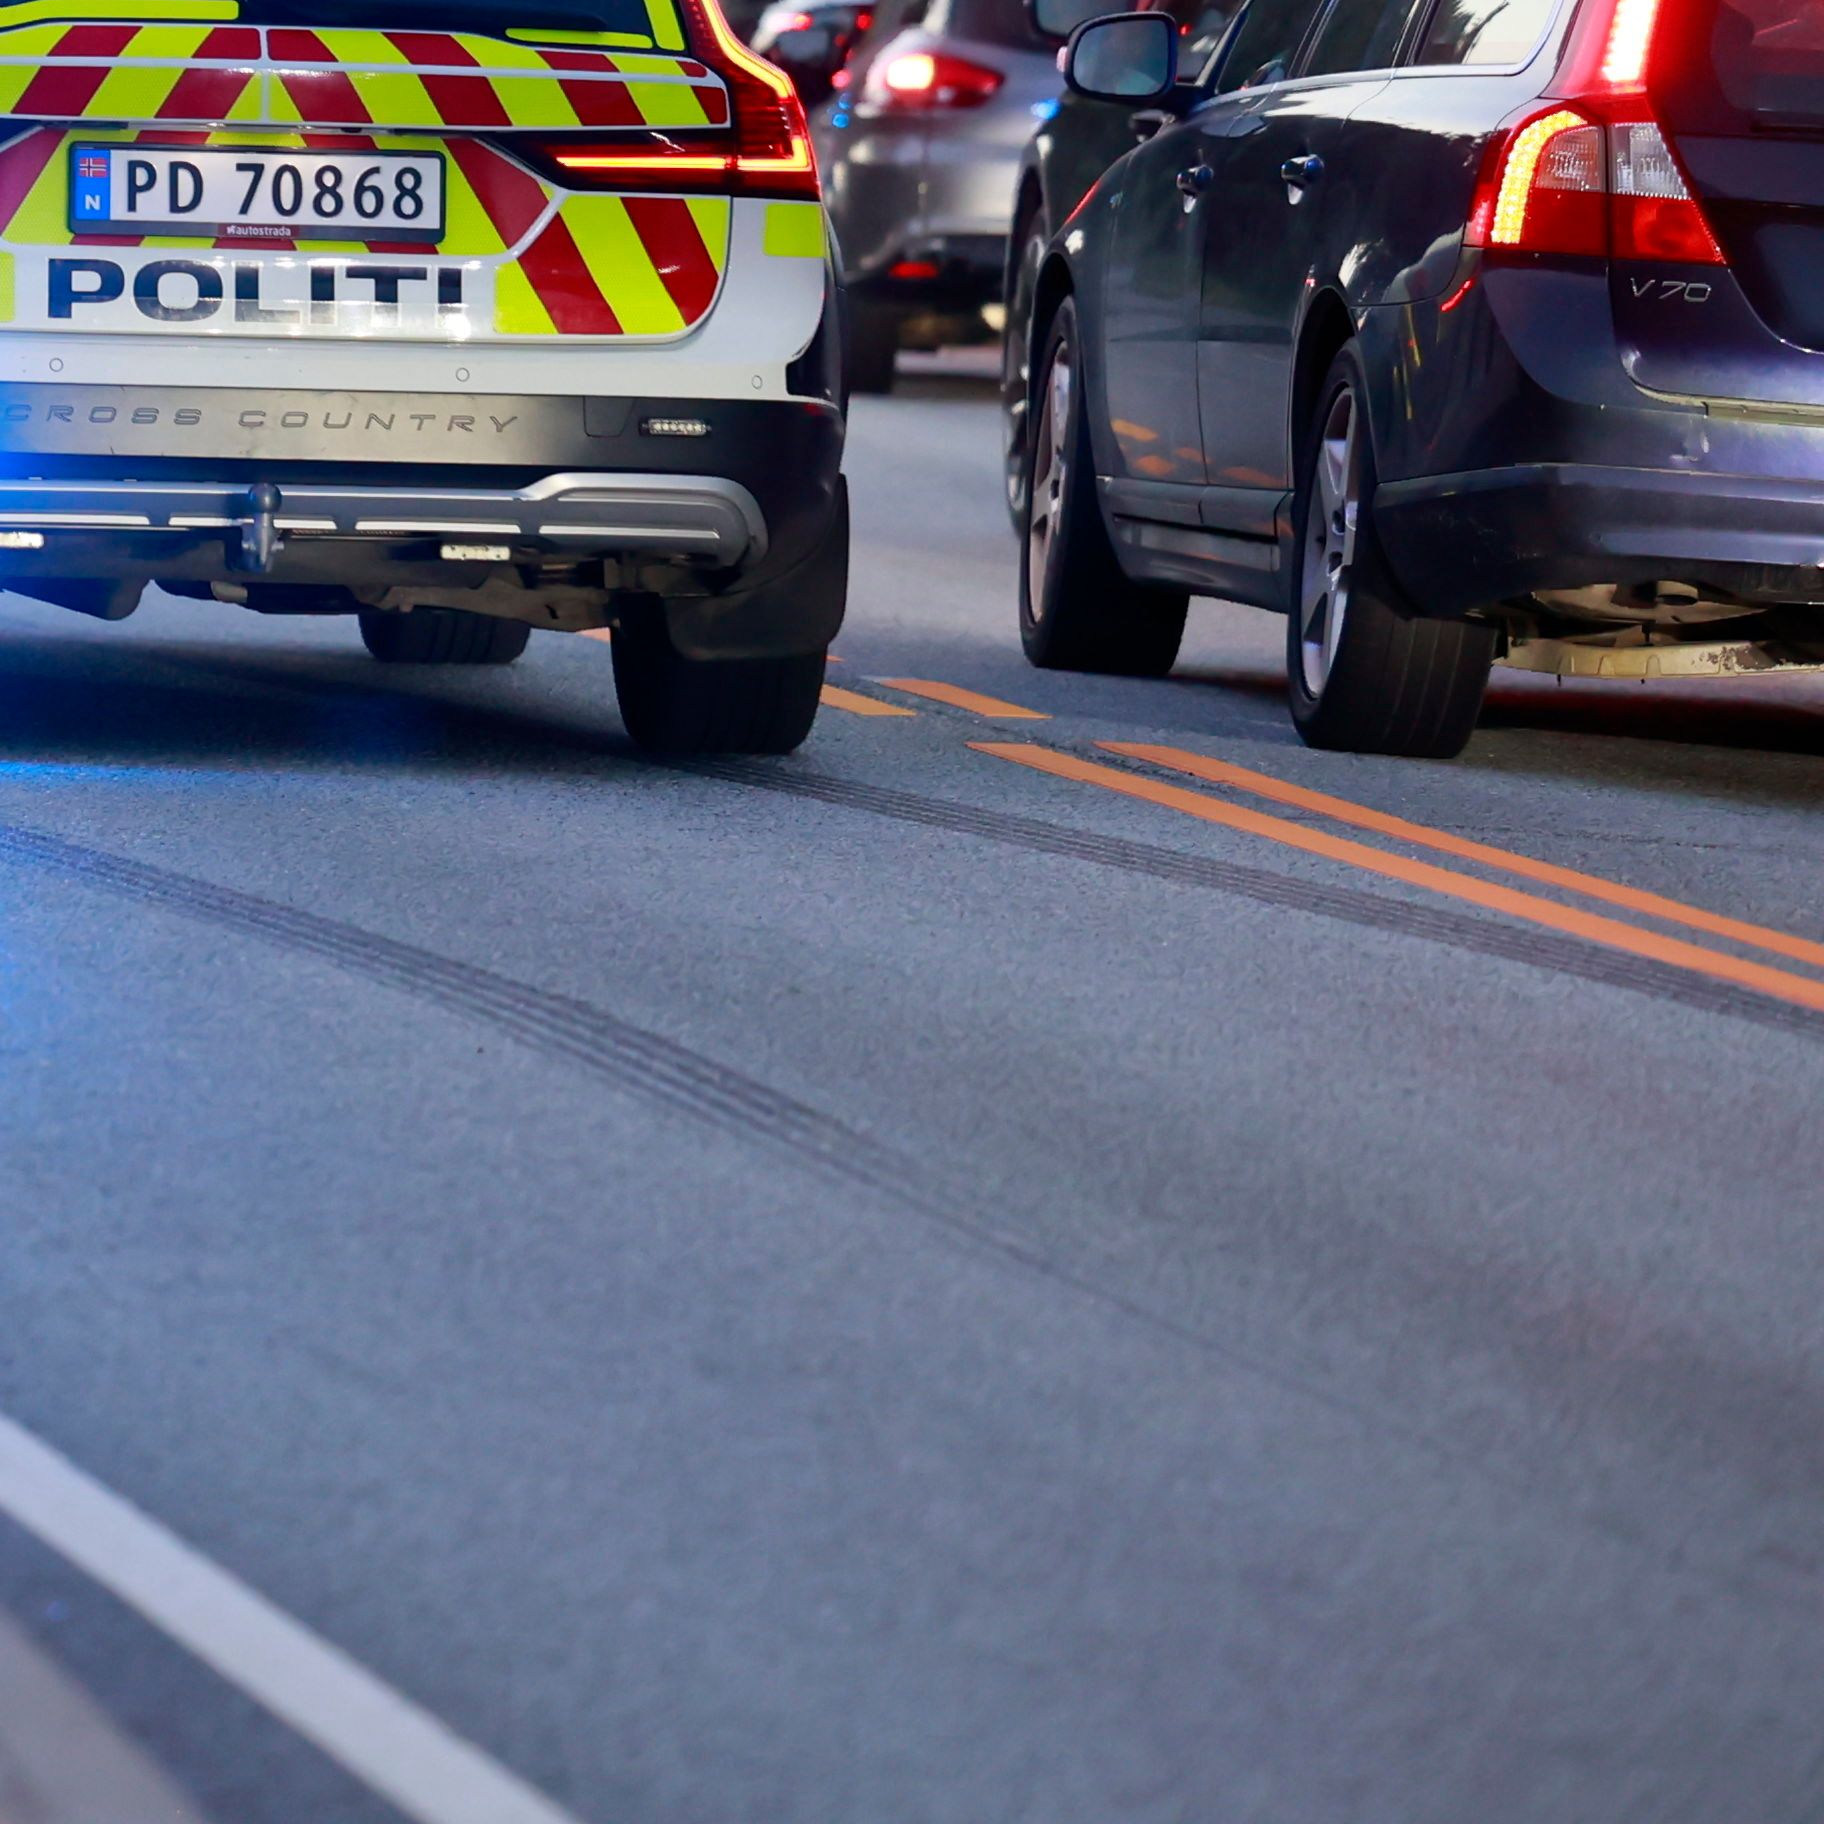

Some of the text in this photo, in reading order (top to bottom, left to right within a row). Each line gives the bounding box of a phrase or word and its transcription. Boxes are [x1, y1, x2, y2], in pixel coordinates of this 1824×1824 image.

[84, 195, 101, 211] N
[127, 159, 425, 220] PD 70868
[236, 224, 292, 237] autostrada
[48, 258, 464, 327] POLITI
[1630, 277, 1712, 303] V70
[4, 403, 518, 433] CROSS COUNTRY
